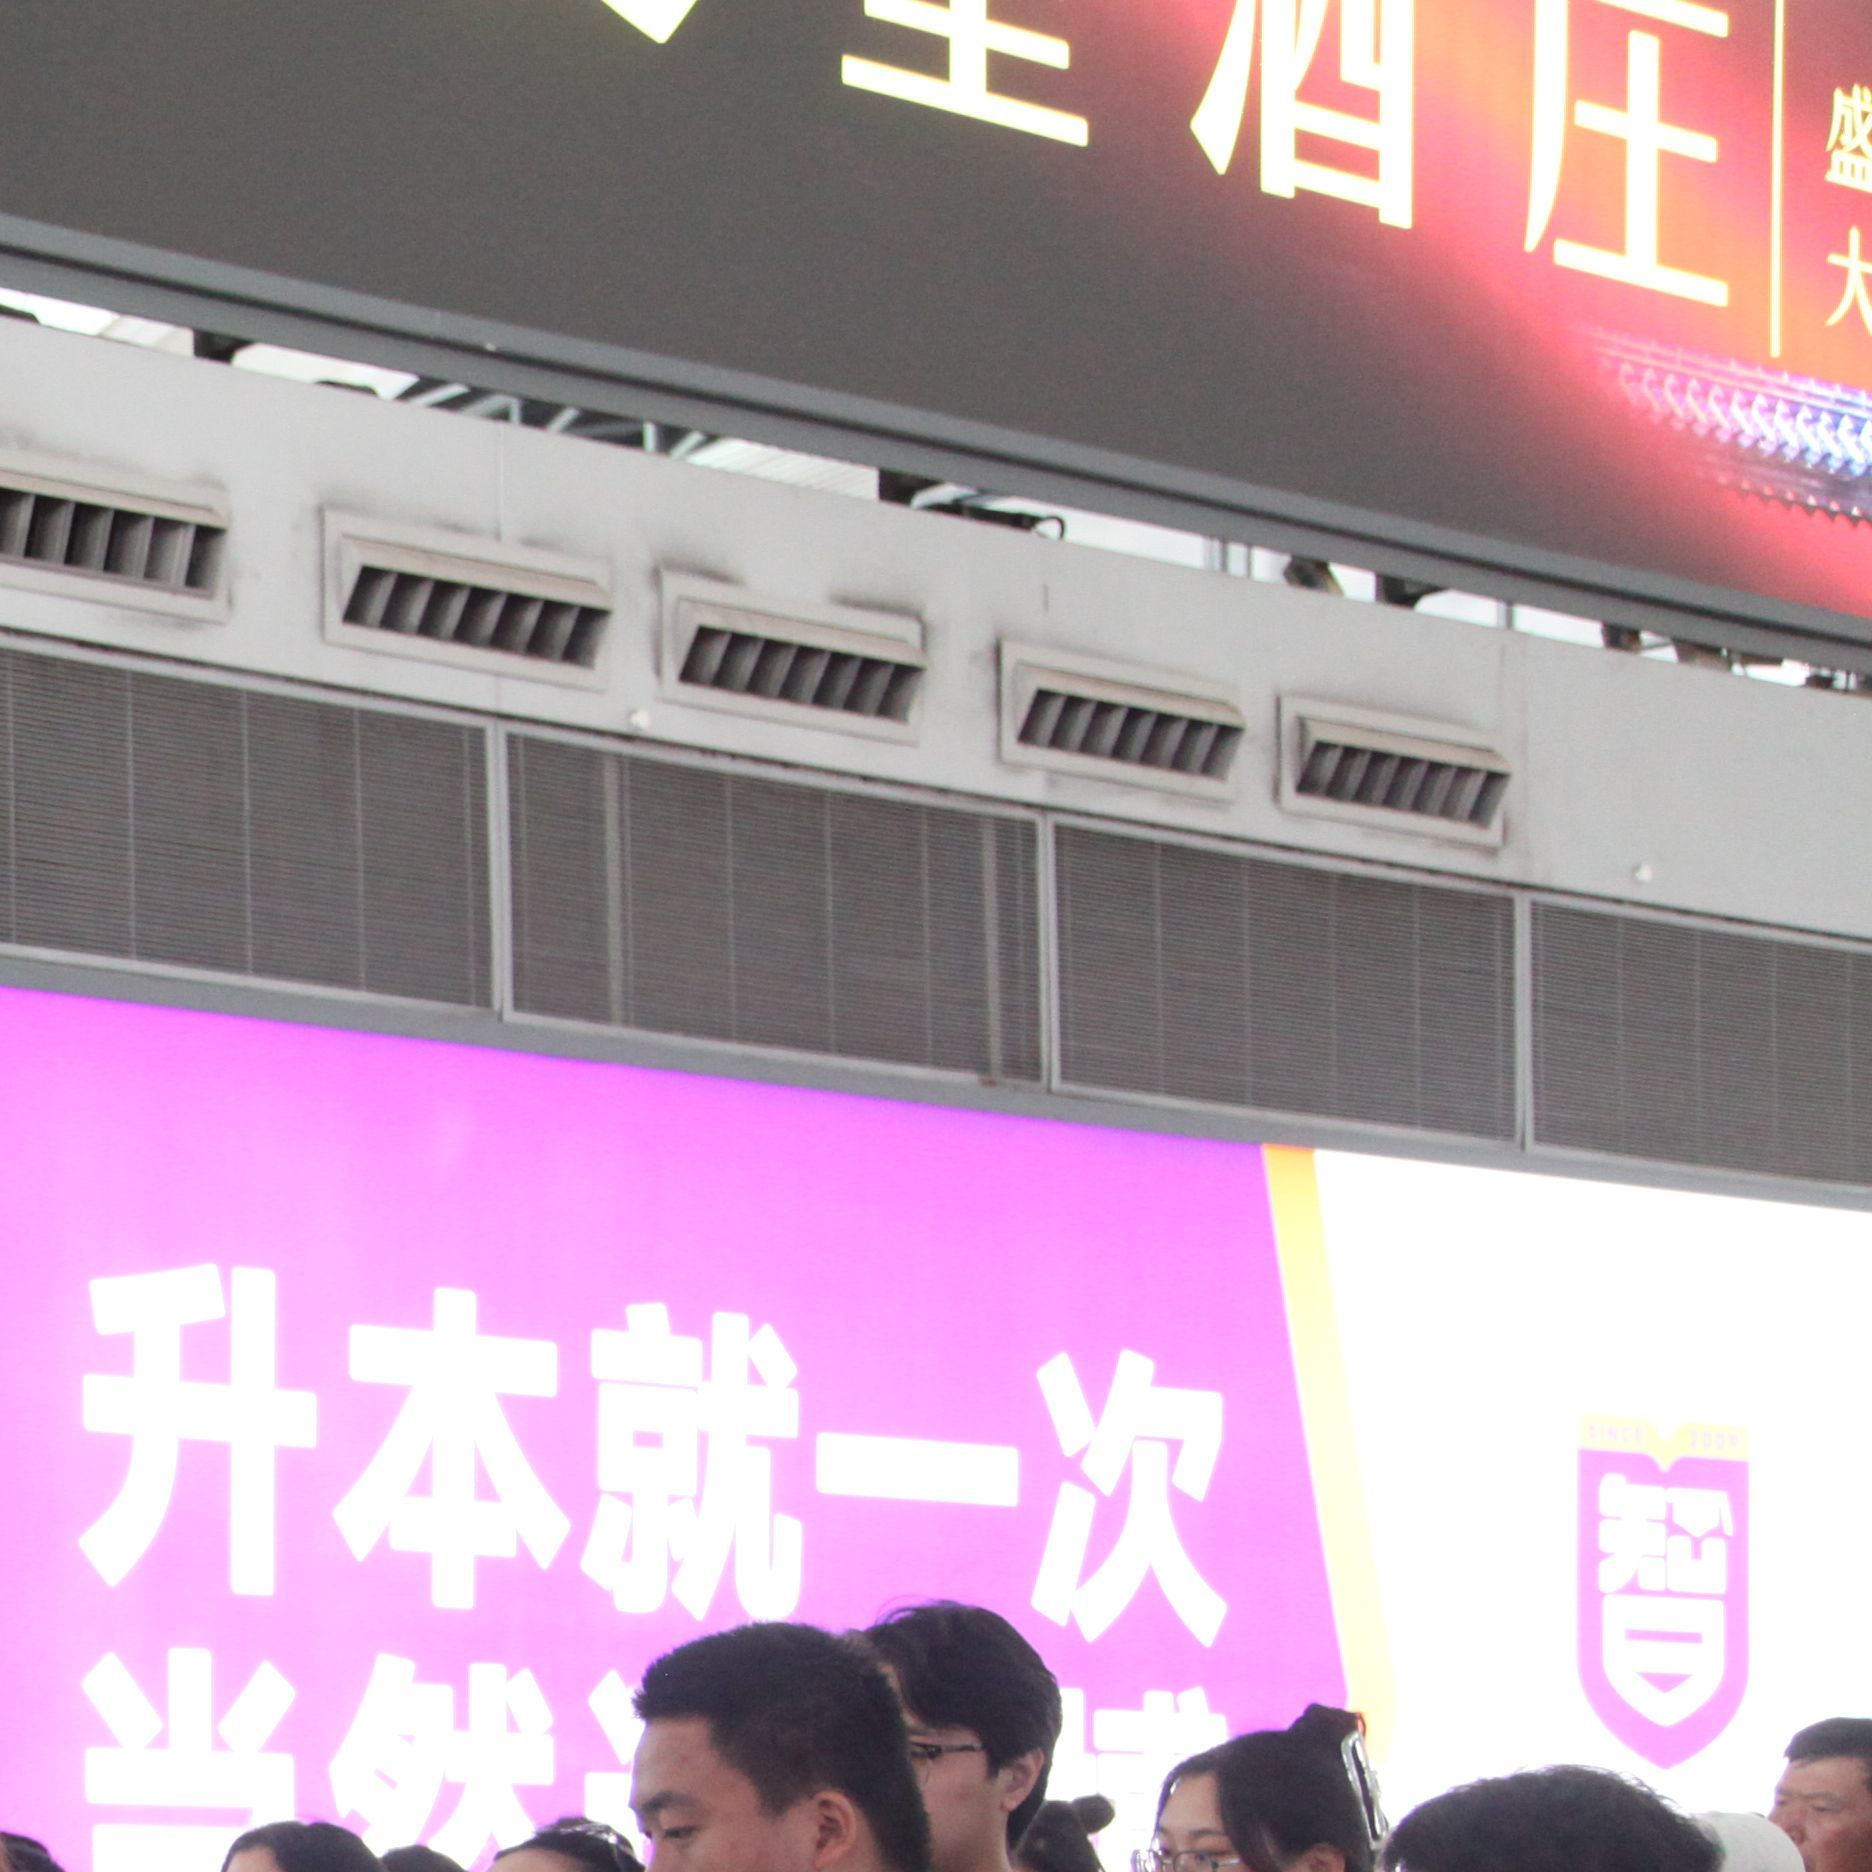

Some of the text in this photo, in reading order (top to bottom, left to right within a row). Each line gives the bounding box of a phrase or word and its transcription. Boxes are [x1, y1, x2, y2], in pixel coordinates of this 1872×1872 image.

[78, 1261, 1228, 1648] 升本就一次
